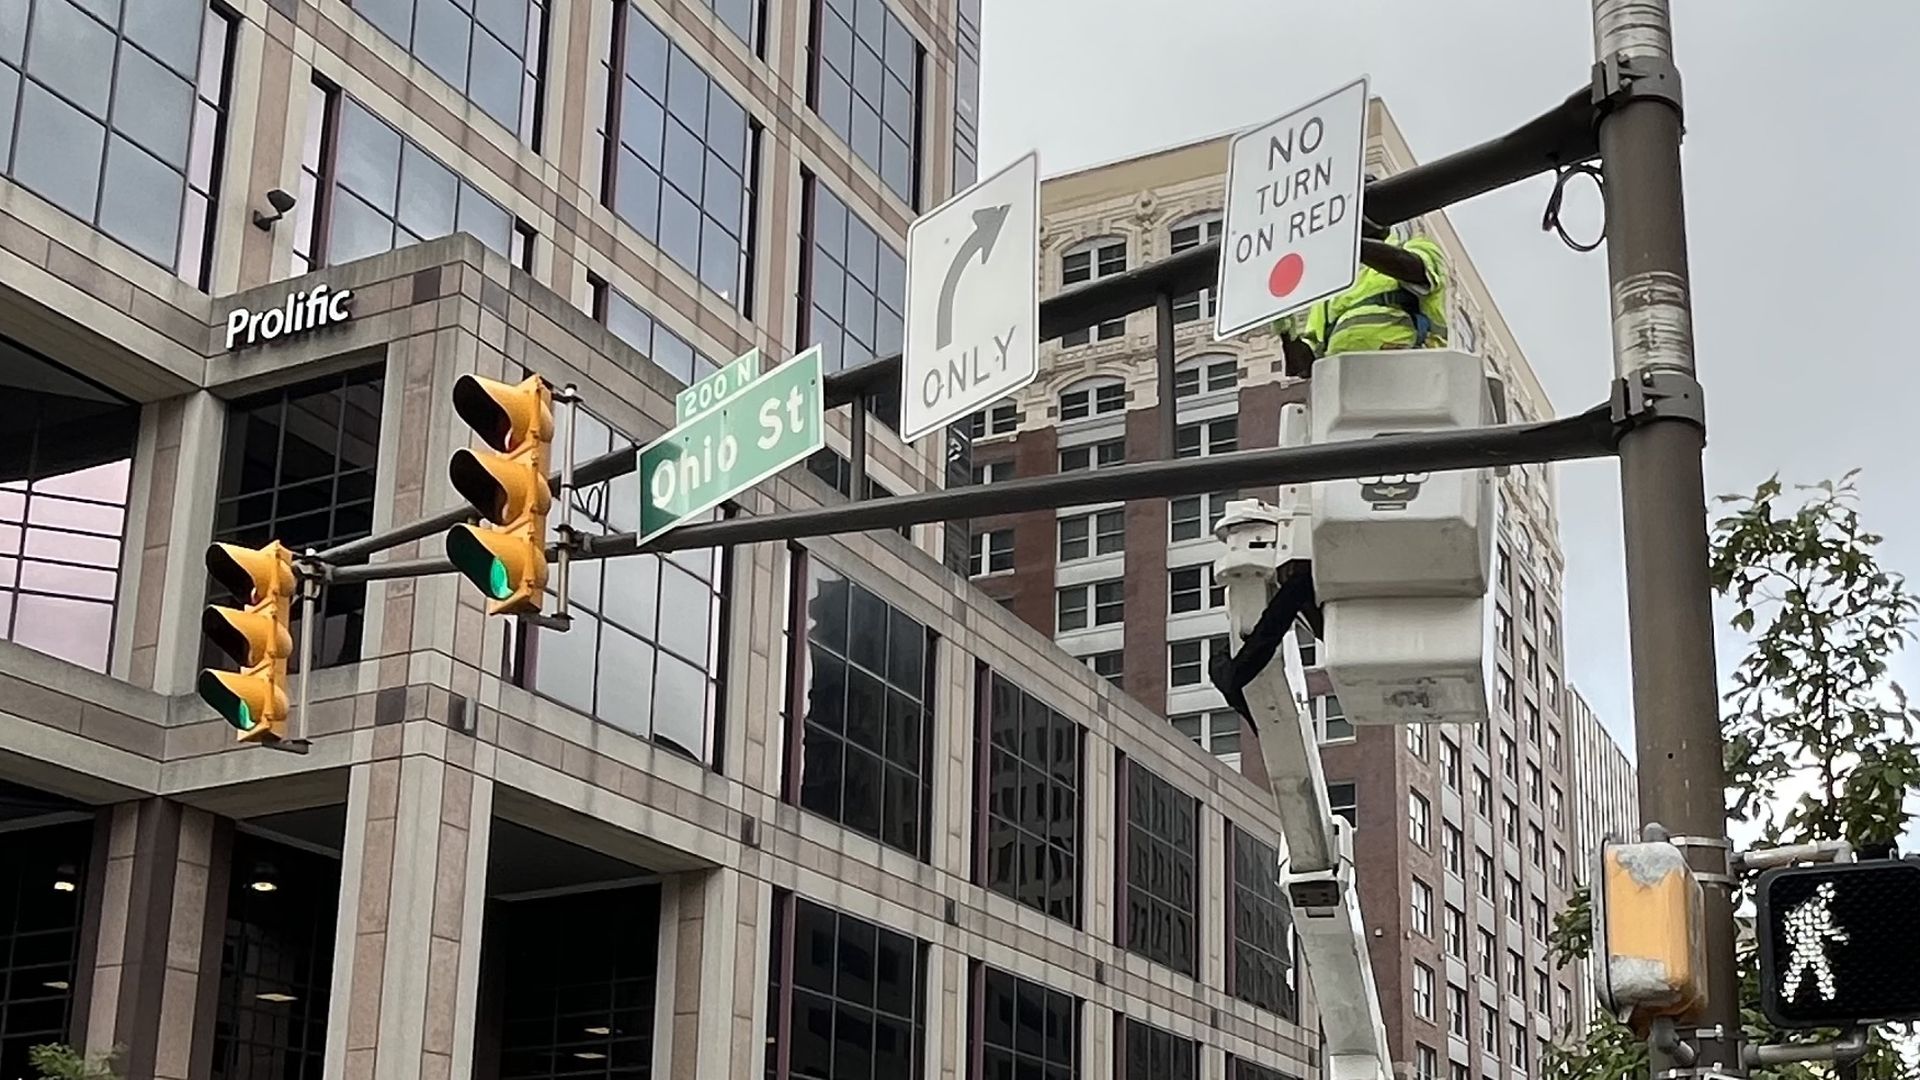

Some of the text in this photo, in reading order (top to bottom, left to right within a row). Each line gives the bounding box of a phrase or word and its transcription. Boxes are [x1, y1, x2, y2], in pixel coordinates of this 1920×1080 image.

[1267, 116, 1324, 171] NO
[1256, 157, 1333, 215] TURN
[1236, 194, 1346, 263] ON RED
[225, 284, 350, 349] Prolific
[683, 357, 751, 418] 200 N
[922, 324, 1017, 409] ONLY
[651, 384, 805, 509] Ohio St
